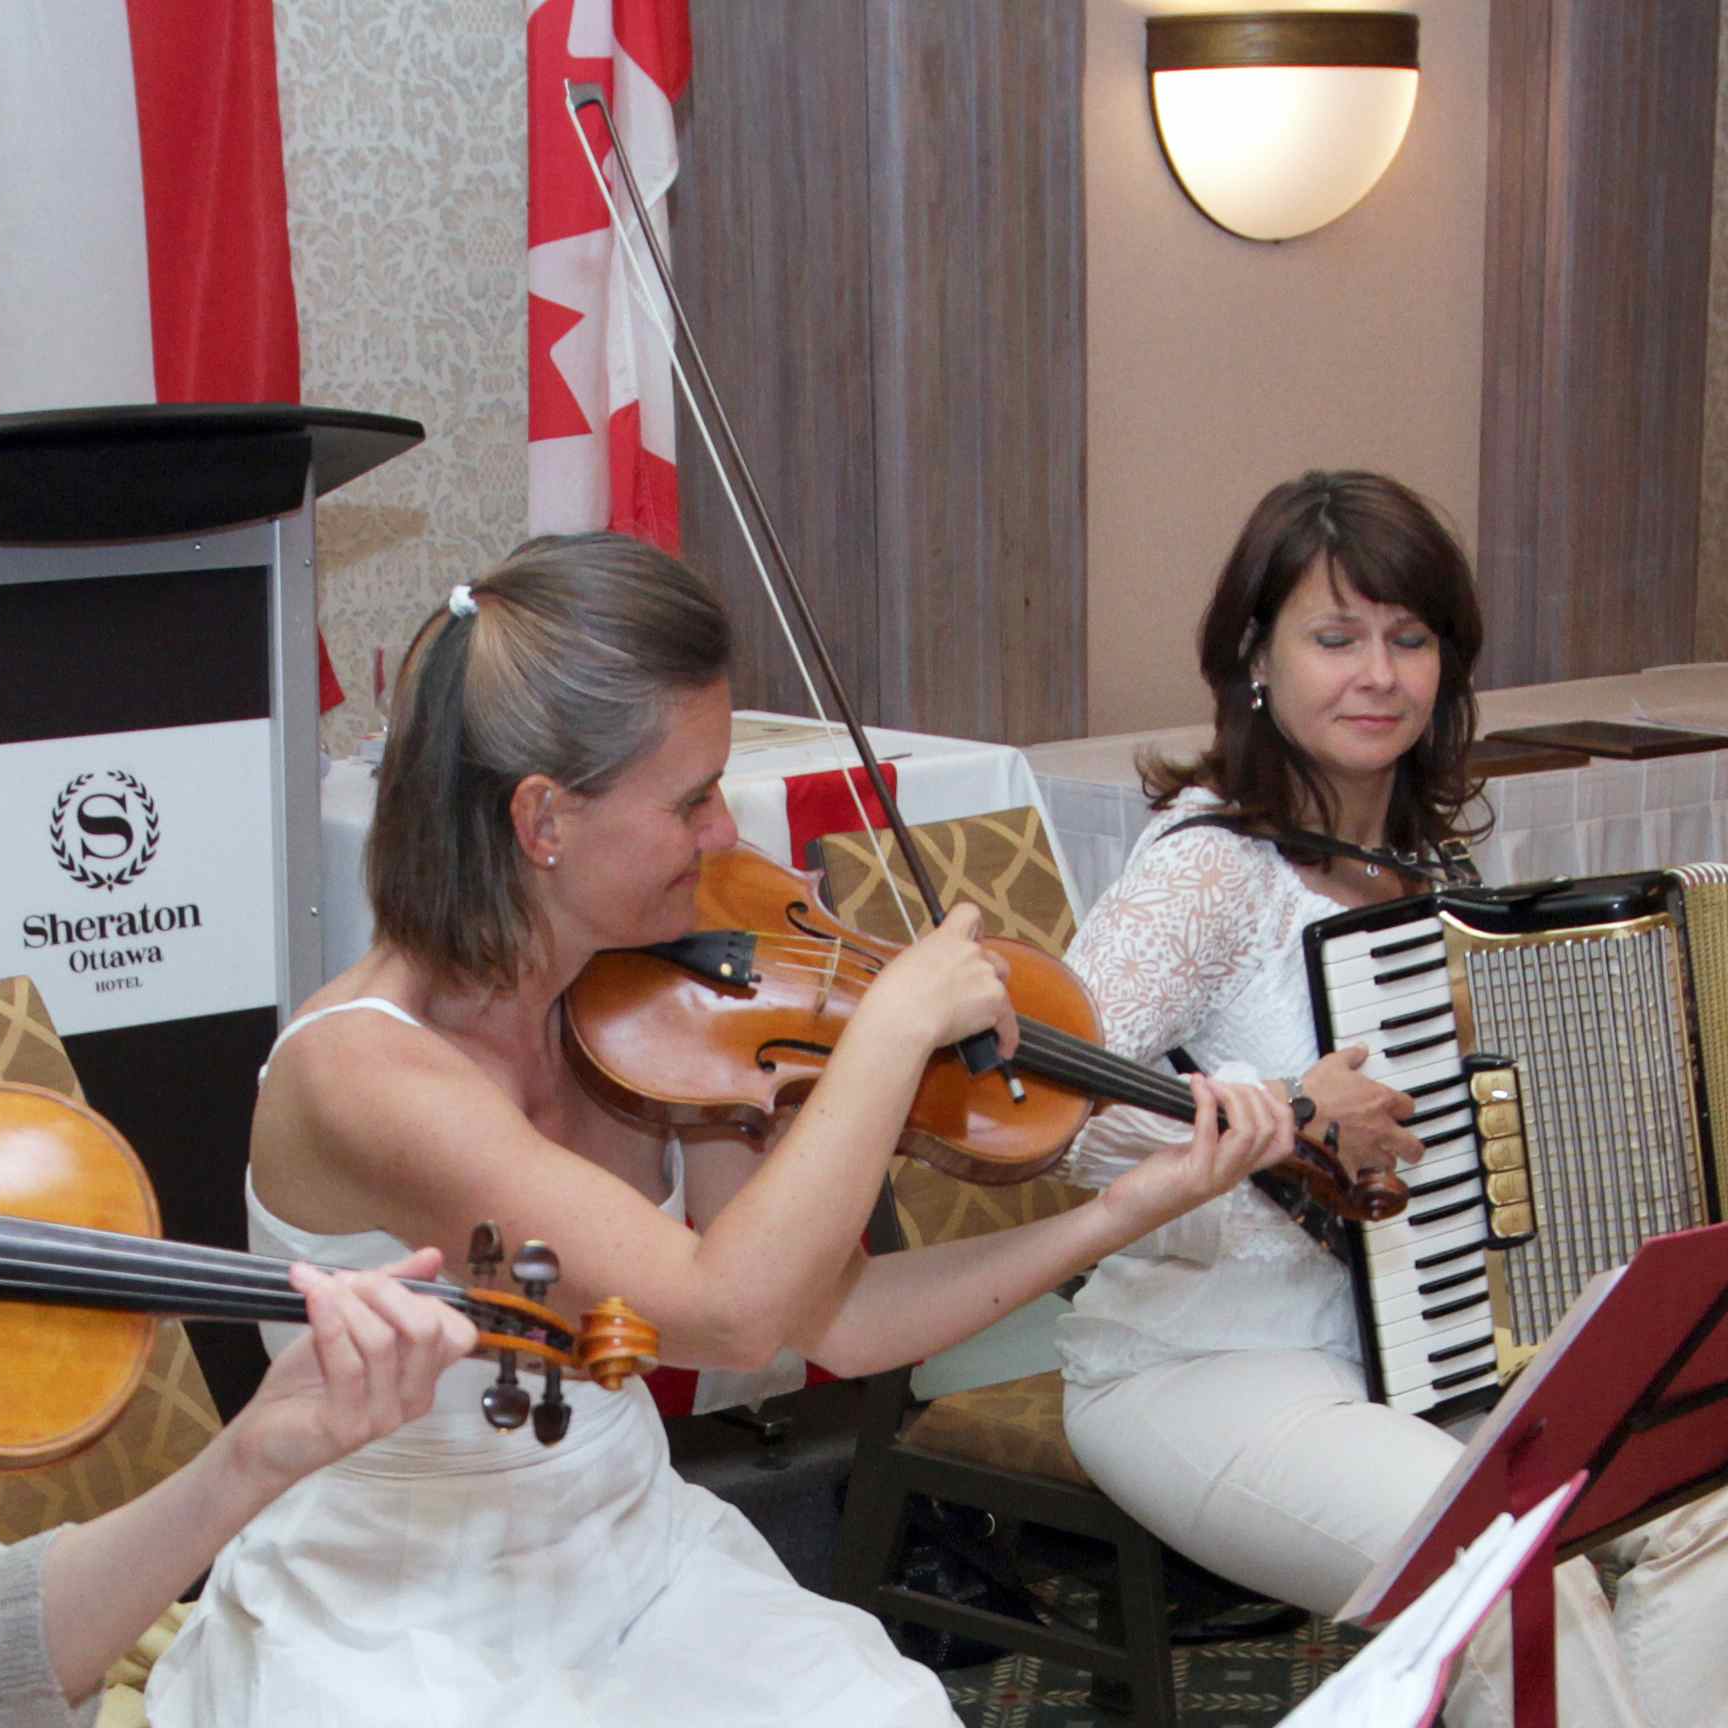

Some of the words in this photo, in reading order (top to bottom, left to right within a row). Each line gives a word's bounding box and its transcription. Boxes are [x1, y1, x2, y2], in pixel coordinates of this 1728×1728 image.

[76, 793, 134, 860] S
[22, 902, 203, 949] Sheraton
[69, 945, 163, 974] Ottawa
[95, 977, 144, 993] HOTEL
